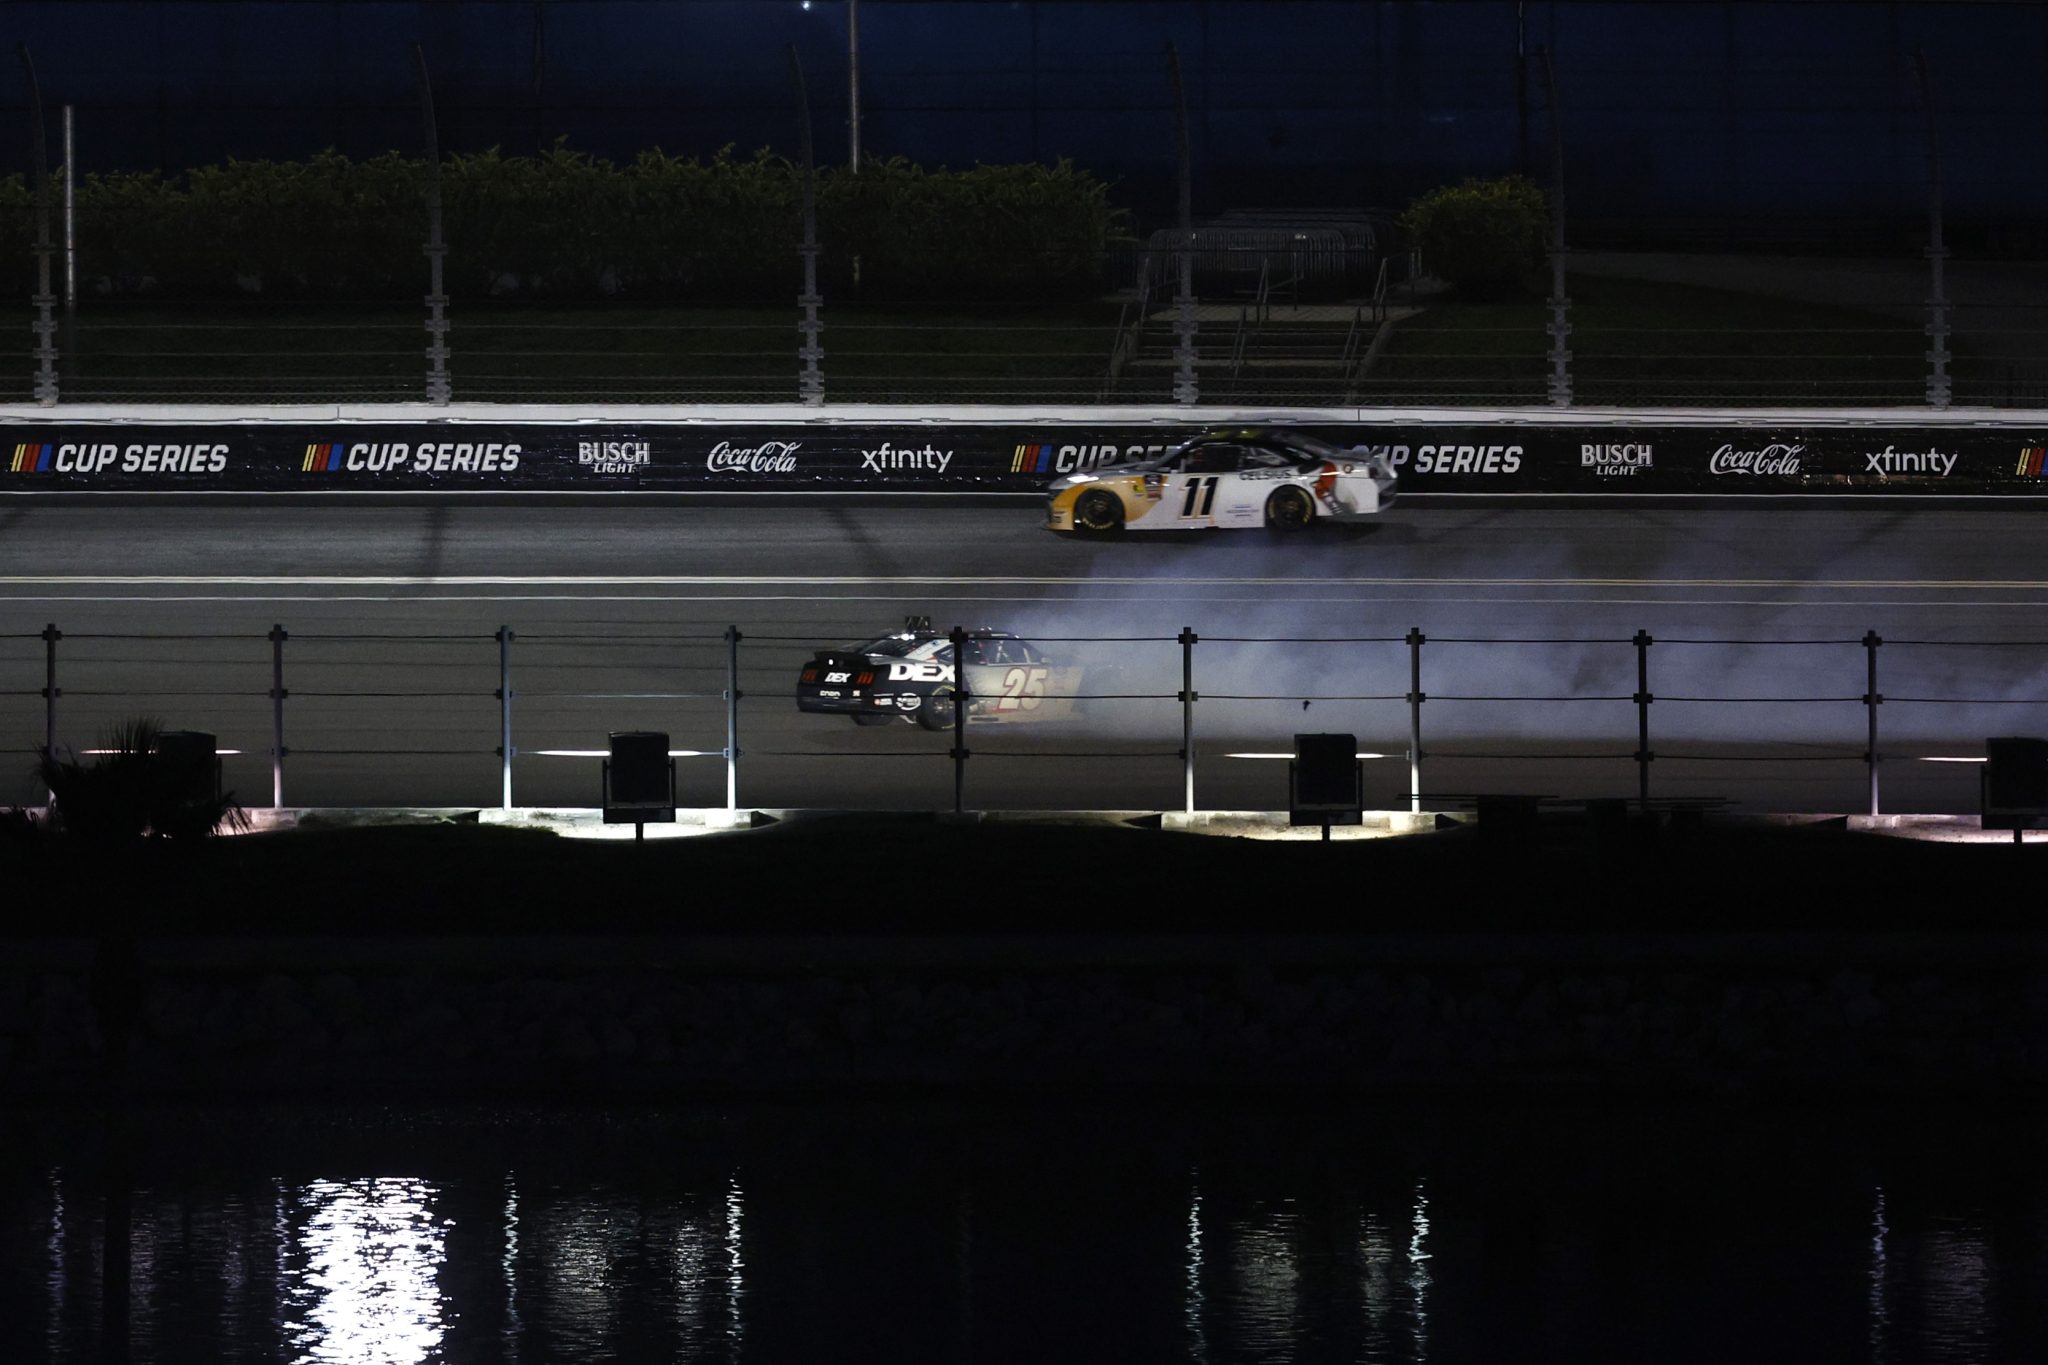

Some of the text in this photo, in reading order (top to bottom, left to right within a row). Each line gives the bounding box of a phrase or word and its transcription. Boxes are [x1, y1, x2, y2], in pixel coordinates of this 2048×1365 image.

[55, 444, 230, 473] CUP SERIES
[346, 443, 522, 472] CUP SERIES
[578, 441, 651, 464] BUSCH
[706, 440, 802, 474] Coca-Cola
[860, 441, 954, 474] xfinity
[1055, 445, 1118, 473] CUP
[1414, 445, 1524, 473] SERIES
[1580, 443, 1653, 467] BUSCH
[1709, 442, 1805, 476] Coca-Cola
[1865, 444, 1958, 477] xfinity
[592, 462, 642, 474] LIGHT
[1596, 464, 1639, 476] LIGHT
[1177, 475, 1220, 520] 11
[824, 671, 853, 684] DEX
[999, 667, 1047, 711] 25
